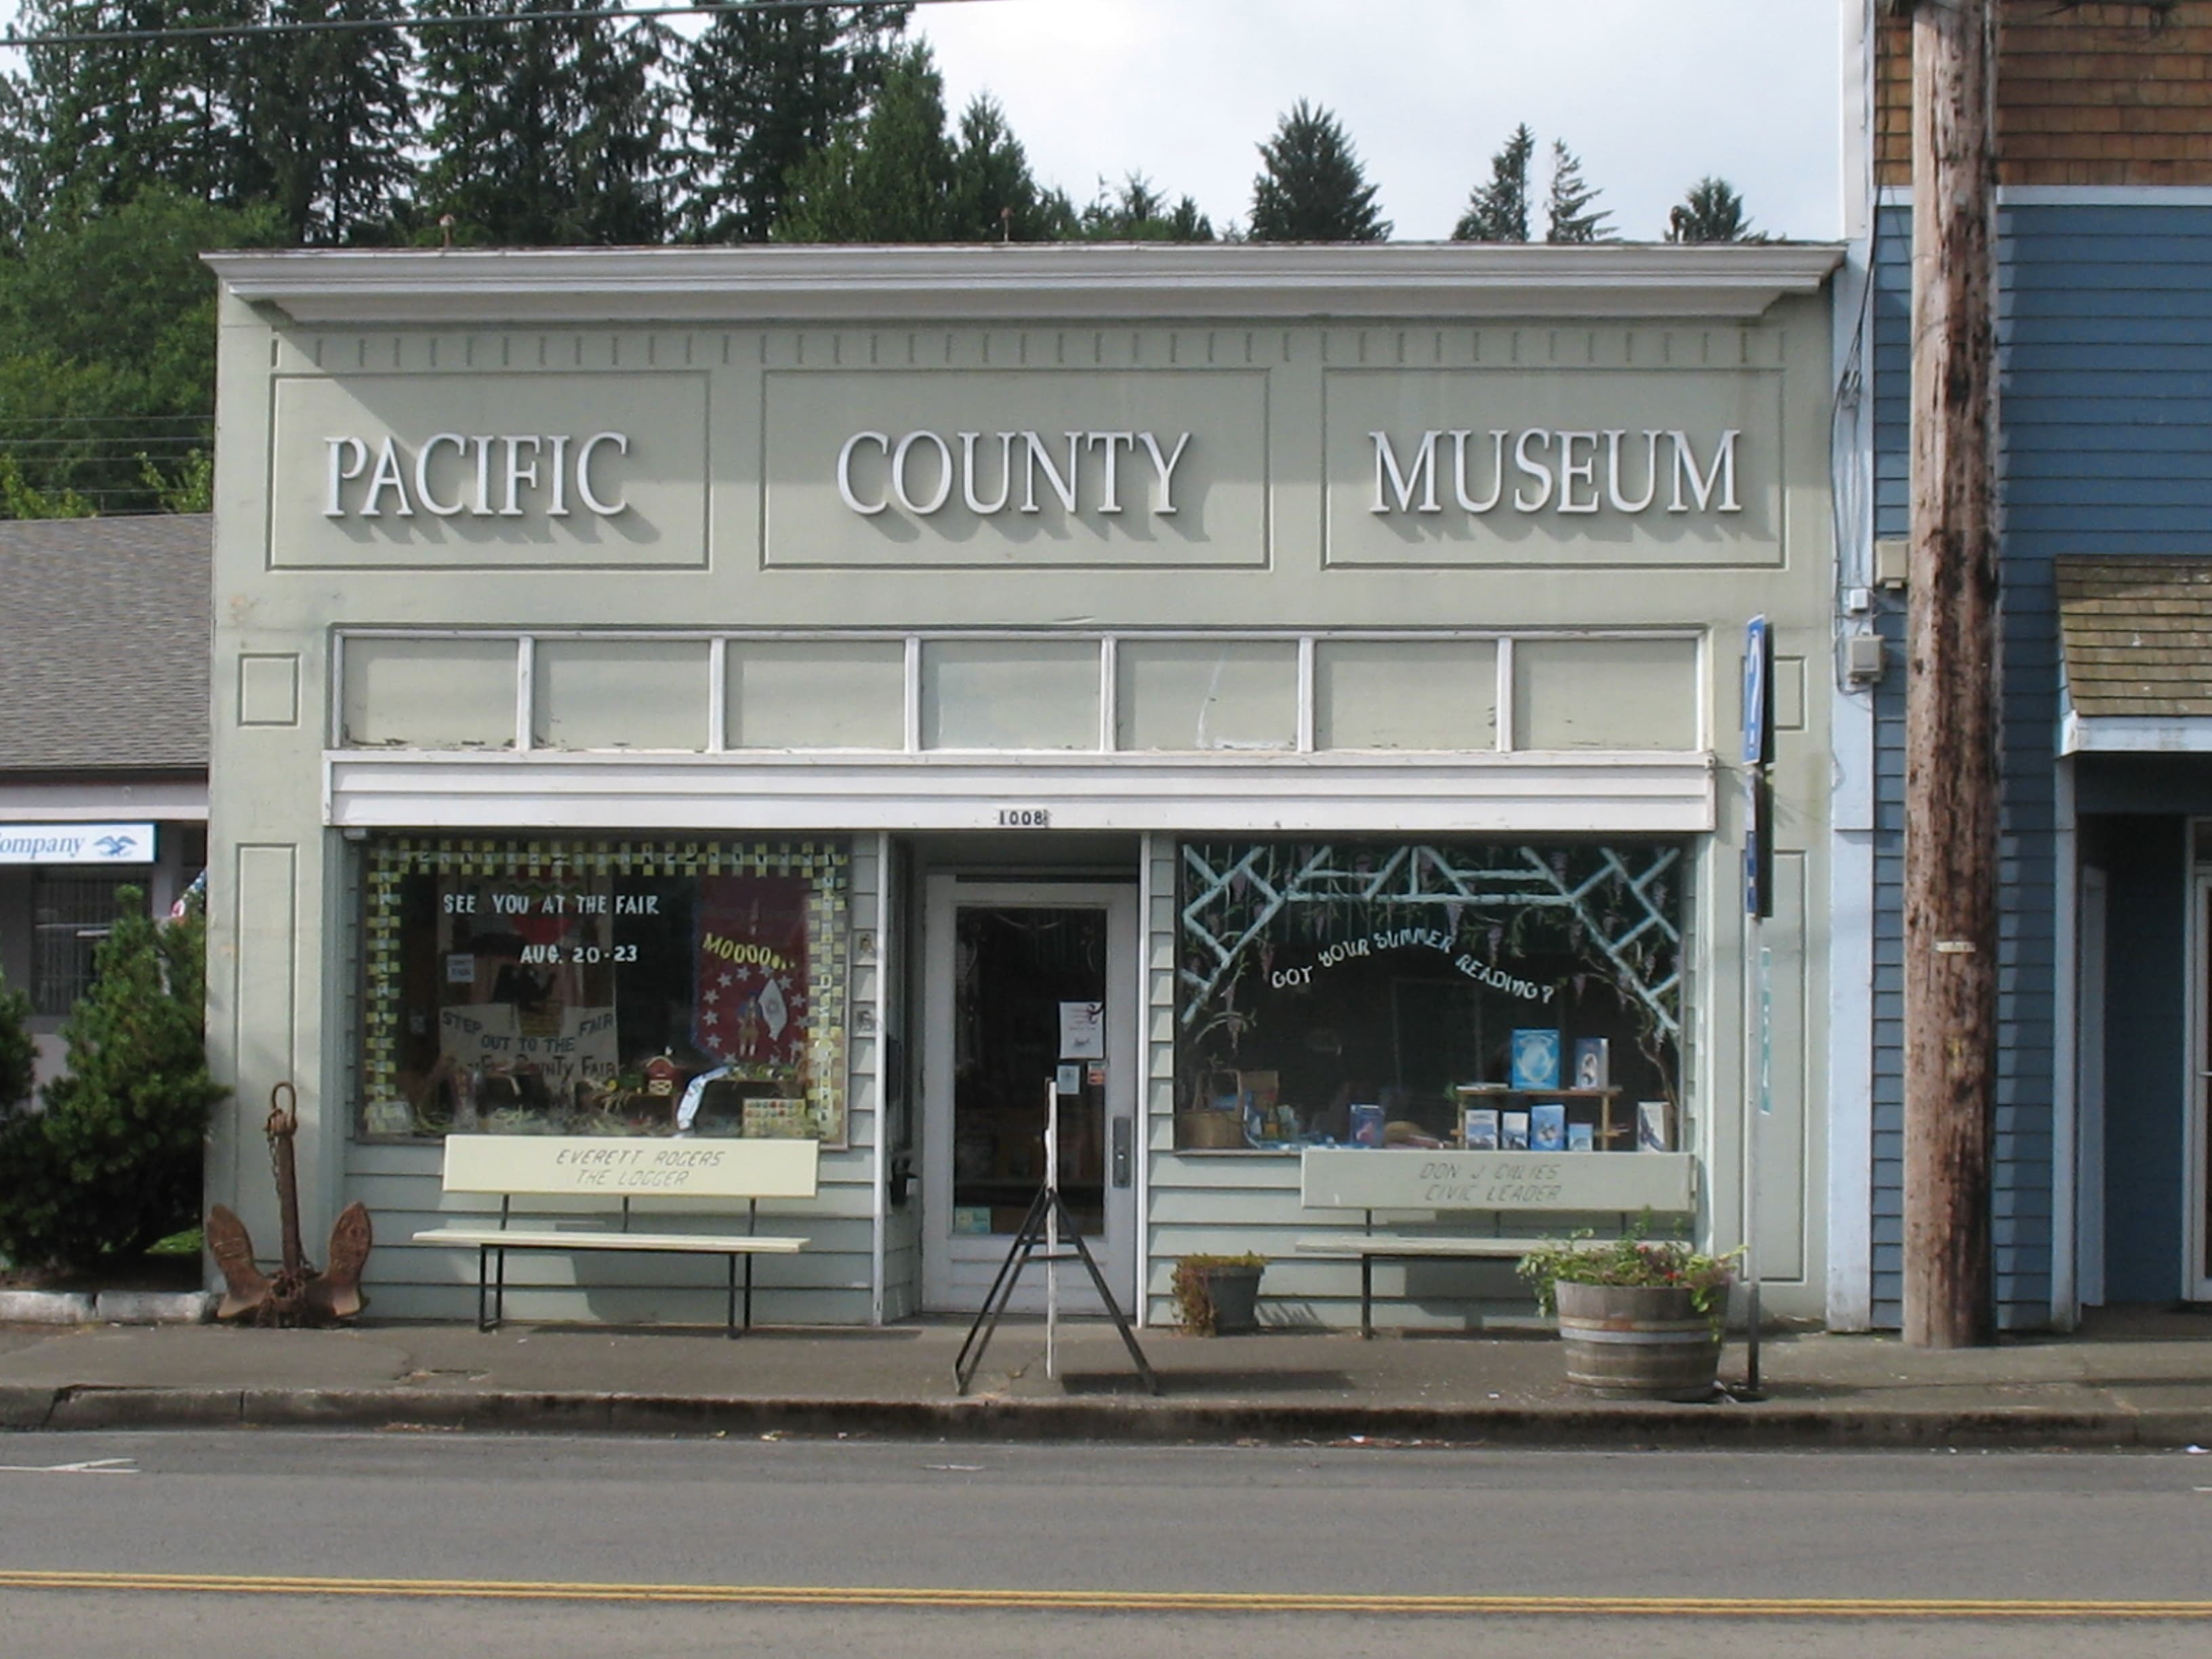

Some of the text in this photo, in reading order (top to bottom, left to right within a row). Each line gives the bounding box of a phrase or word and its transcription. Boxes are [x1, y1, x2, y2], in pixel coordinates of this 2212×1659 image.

[323, 428, 1742, 516] PACIFIC COUNTY MUSEUM
[999, 810, 1042, 825] 1008
[0, 831, 85, 860] ompany
[443, 894, 659, 915] SEE YOU AT THE FAIR
[520, 945, 563, 964] AUG.
[1271, 926, 1554, 1004] GOT YOUR SUMMER READING?
[442, 1010, 484, 1036] STEP
[481, 1034, 512, 1050] OUT
[518, 1037, 539, 1051] TO
[544, 1036, 576, 1052] THE
[556, 1148, 726, 1167] EVERETT ROGERS
[575, 1168, 690, 1187] THE LOGGER
[1486, 1184, 1562, 1202] LEADER
